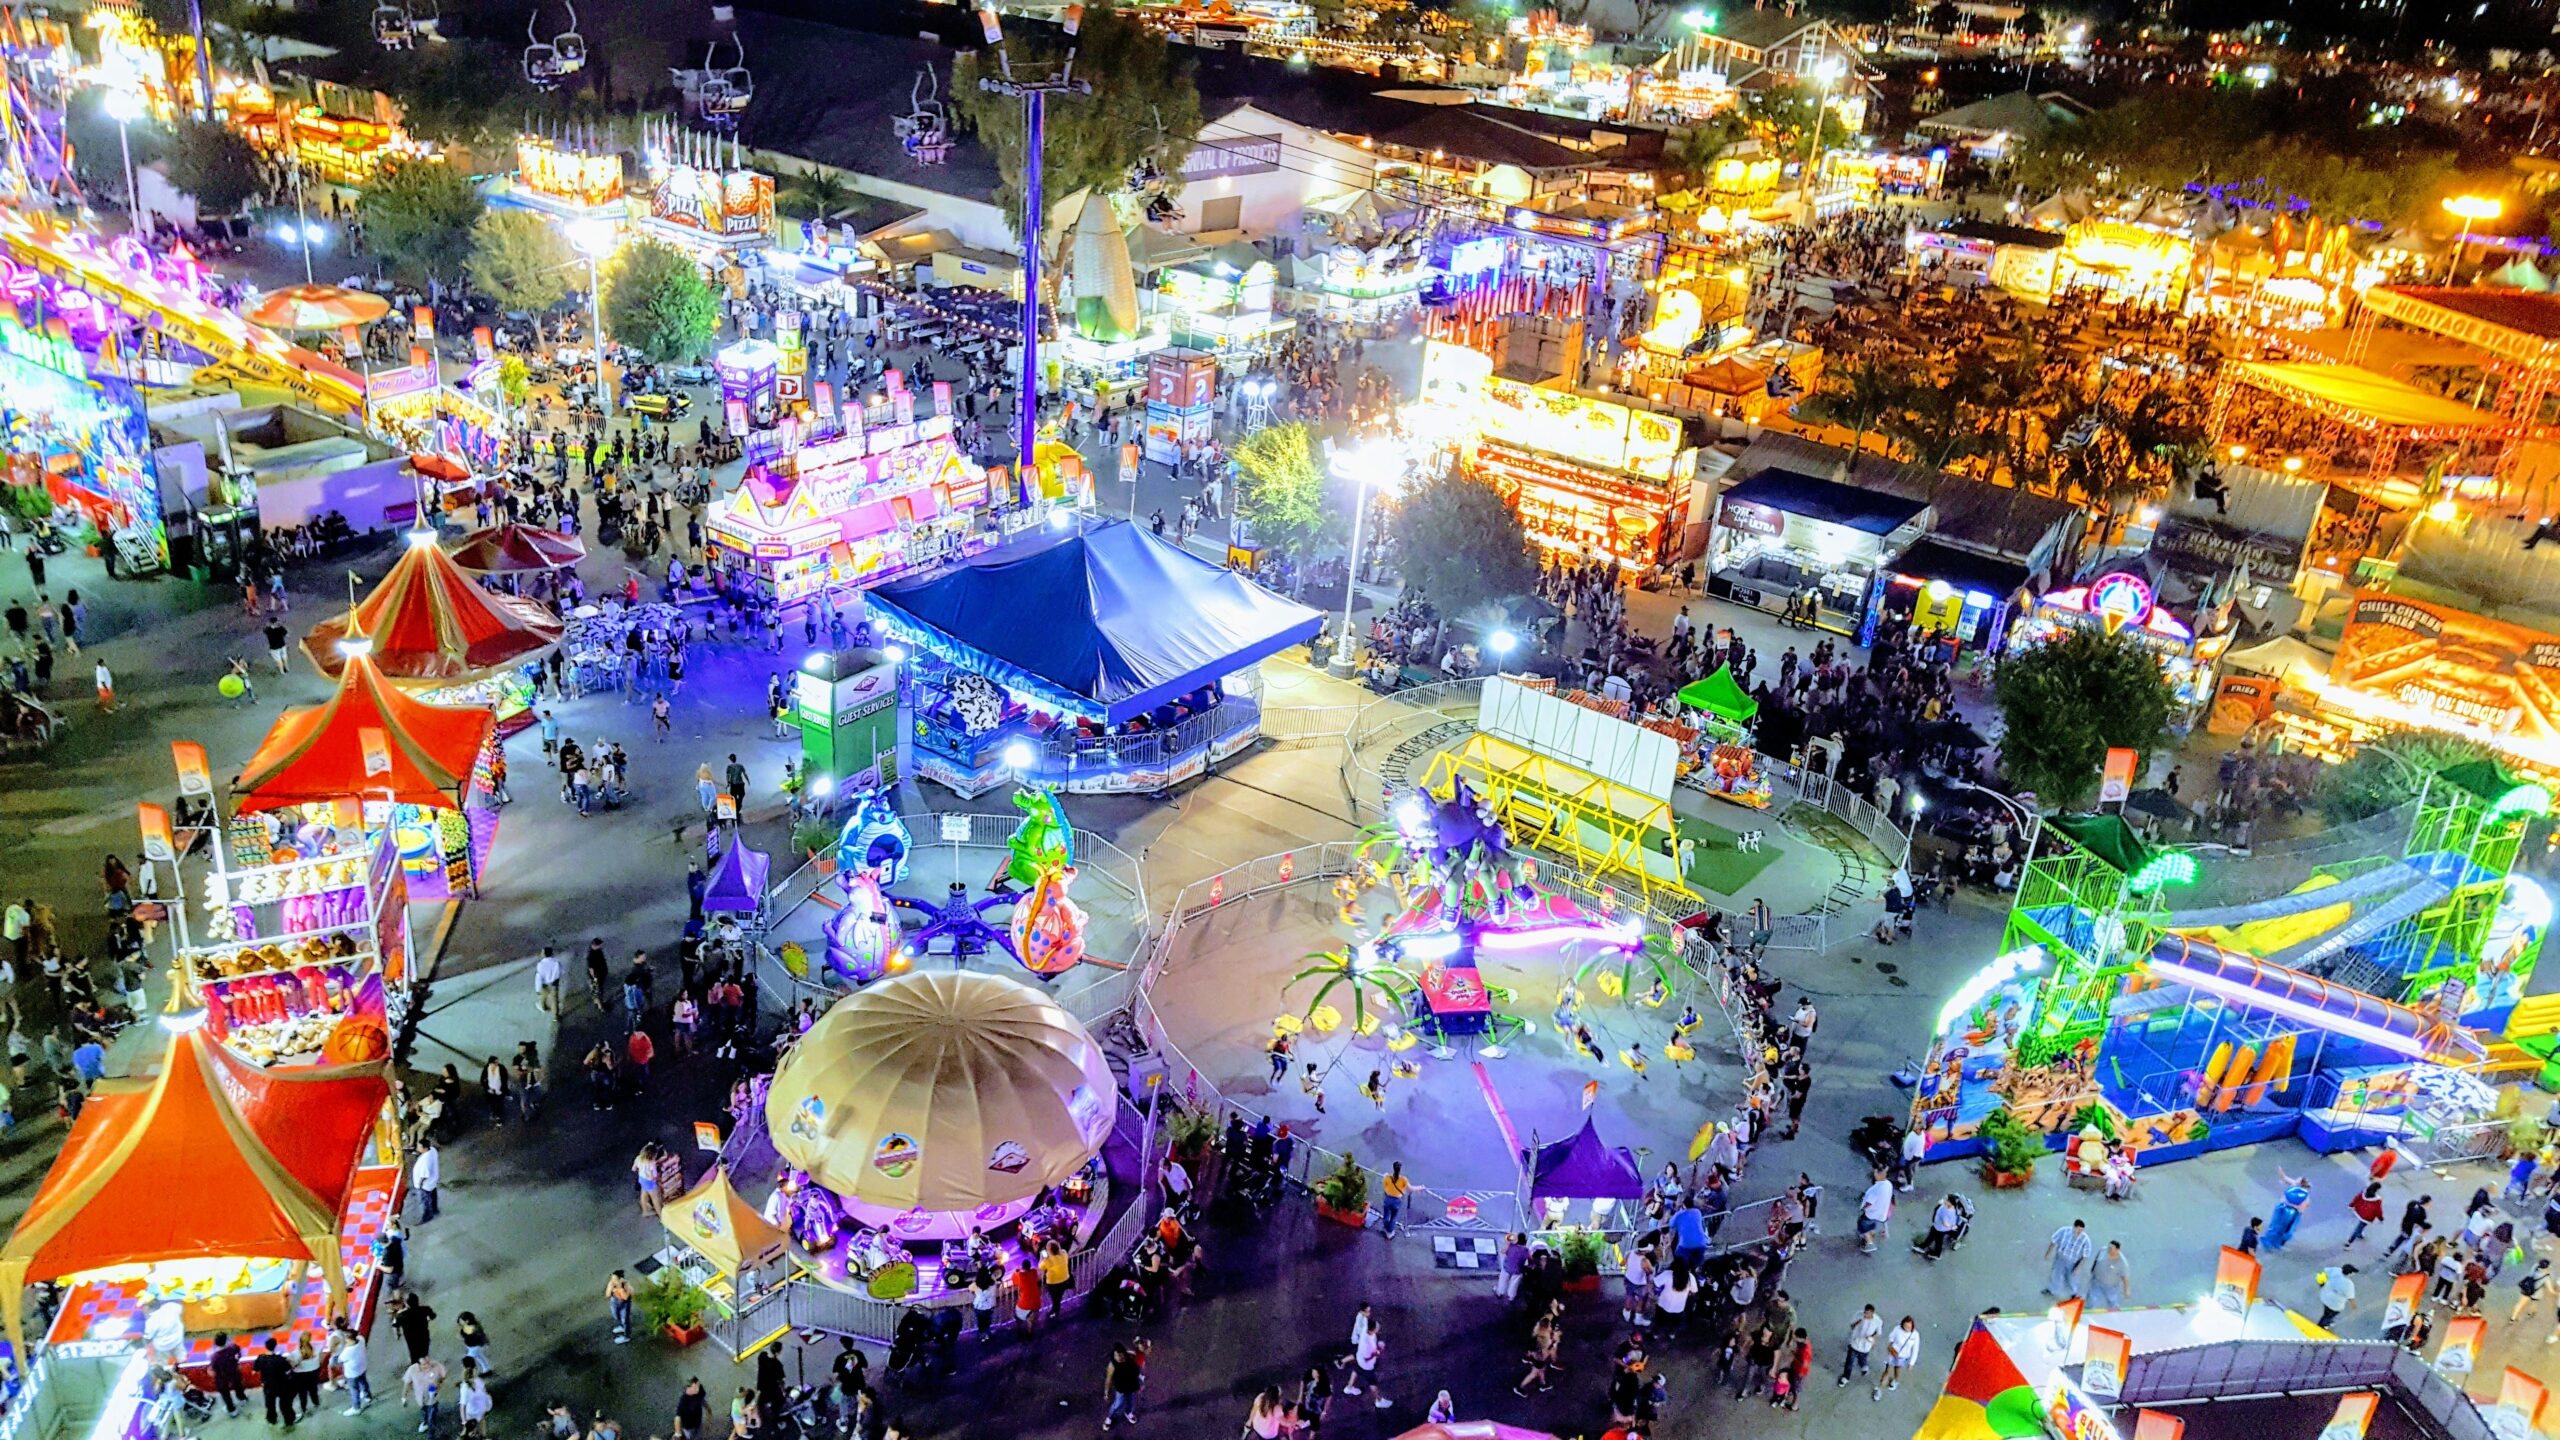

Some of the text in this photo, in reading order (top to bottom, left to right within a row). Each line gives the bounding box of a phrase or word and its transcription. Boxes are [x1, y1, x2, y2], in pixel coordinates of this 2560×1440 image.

[1219, 147, 1233, 169] OF
[1232, 142, 1279, 167] PRODUCTS
[666, 192, 705, 225] PIZZA
[726, 215, 758, 231] PIZZA
[2392, 298, 2473, 336] HERITAGE
[167, 322, 197, 340] IT'S
[207, 339, 234, 359] FUN
[244, 357, 272, 376] FUN
[1749, 518, 1776, 534] ULTRA
[800, 536, 834, 551] POPCORN
[2188, 531, 2266, 562] HAWAIIAN
[2358, 601, 2444, 633] CHILI CHEESE
[2380, 612, 2417, 631] FRIES
[2229, 684, 2258, 696] FRIES
[2400, 683, 2436, 708] GOOD
[2455, 699, 2506, 725] BURGER
[838, 710, 862, 726] GUEST
[863, 694, 895, 717] SERVICES
